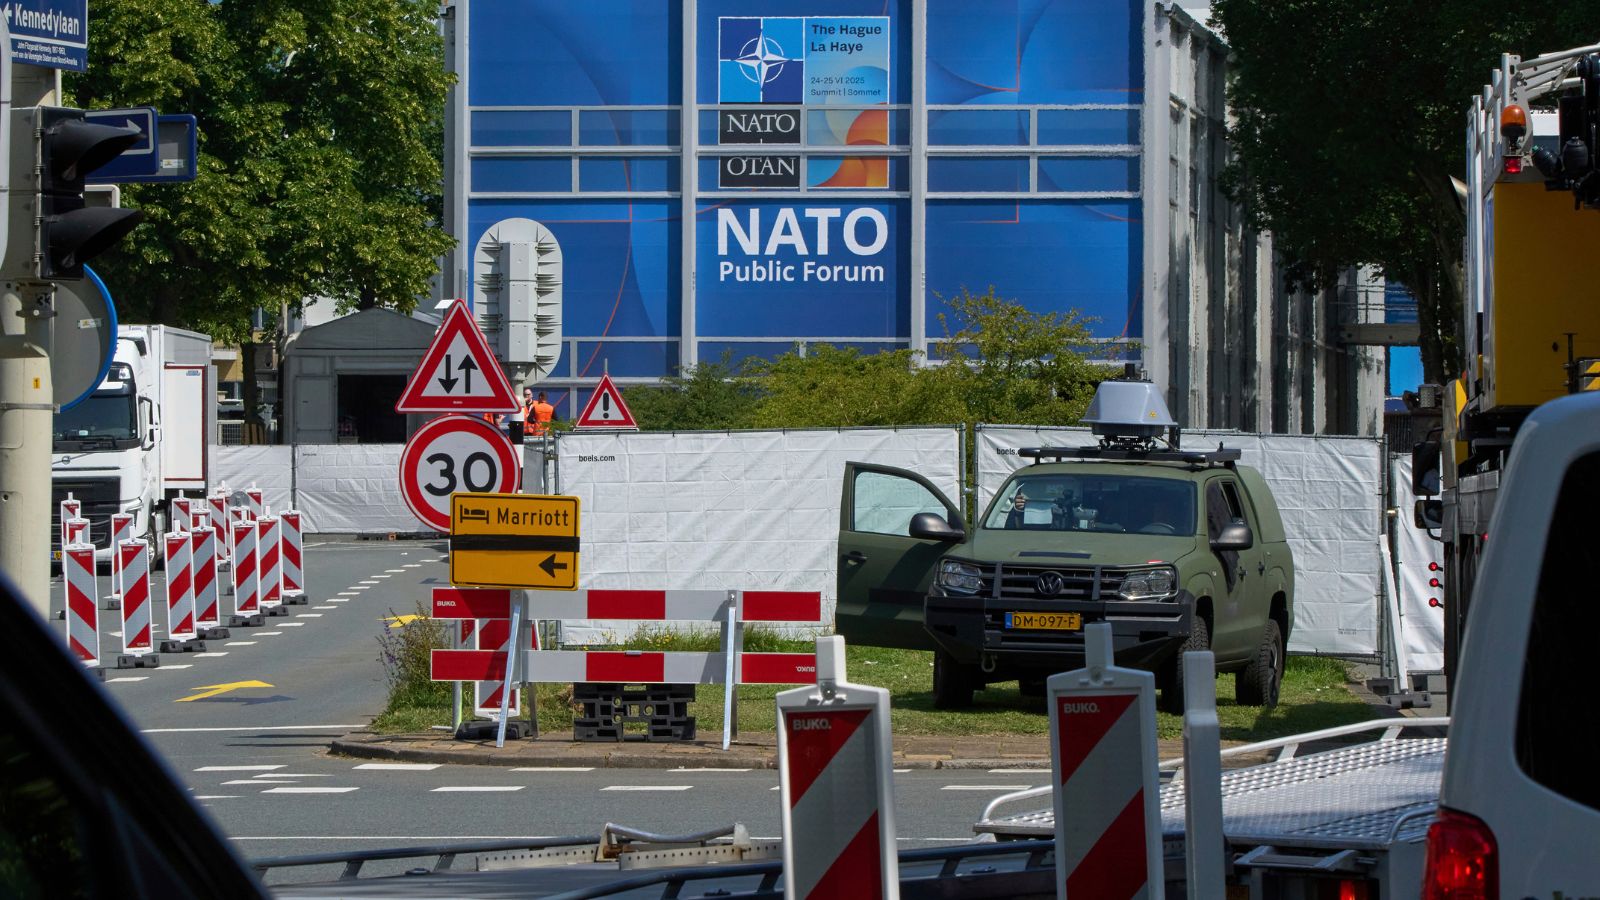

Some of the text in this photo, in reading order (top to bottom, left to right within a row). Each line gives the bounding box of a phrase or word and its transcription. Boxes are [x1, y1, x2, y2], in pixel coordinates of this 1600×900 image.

[15, 3, 79, 37] Kennedylaan
[812, 25, 882, 37] The Hague
[811, 42, 862, 54] La Haye
[727, 113, 796, 133] NATO
[727, 156, 796, 176] OTAN
[718, 207, 888, 256] NATO
[720, 260, 884, 282] Public Forum
[424, 452, 497, 496] 30
[498, 507, 568, 526] Marriott
[1014, 615, 1074, 628] DM-097-F
[1064, 702, 1100, 714] BUKO.
[793, 718, 832, 730] BUKO.
